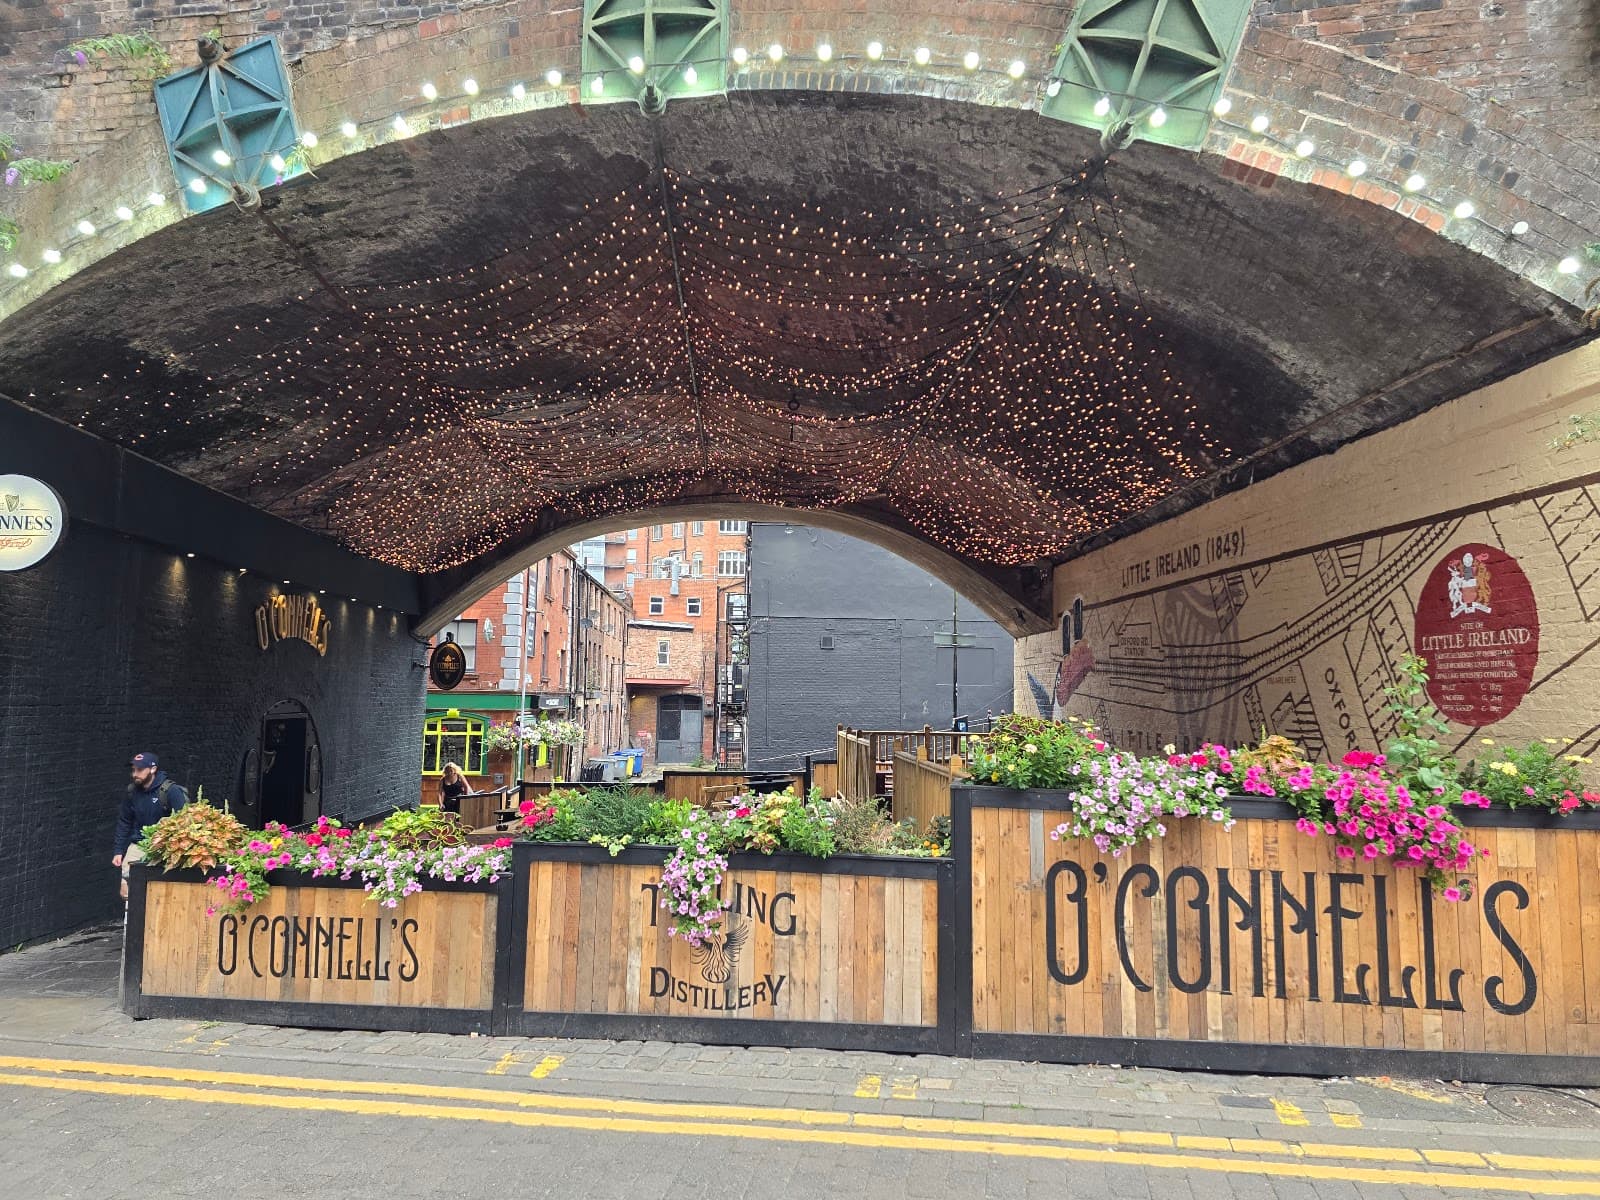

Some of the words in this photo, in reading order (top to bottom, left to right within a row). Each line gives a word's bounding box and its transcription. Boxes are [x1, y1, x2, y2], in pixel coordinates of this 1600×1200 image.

[1122, 560, 1151, 588] LITTLE
[1156, 543, 1200, 578] IRELAND
[1206, 526, 1245, 565] (1849)
[1422, 633, 1464, 651] LITTLE
[1468, 628, 1531, 647] IRELAND
[1325, 667, 1360, 751] OXFOR
[641, 882, 797, 936] TLING
[1046, 860, 1538, 1016] O'CONNELL'S
[218, 914, 419, 982] O'CONNELL'S
[649, 966, 787, 1011] DISTILLERY
